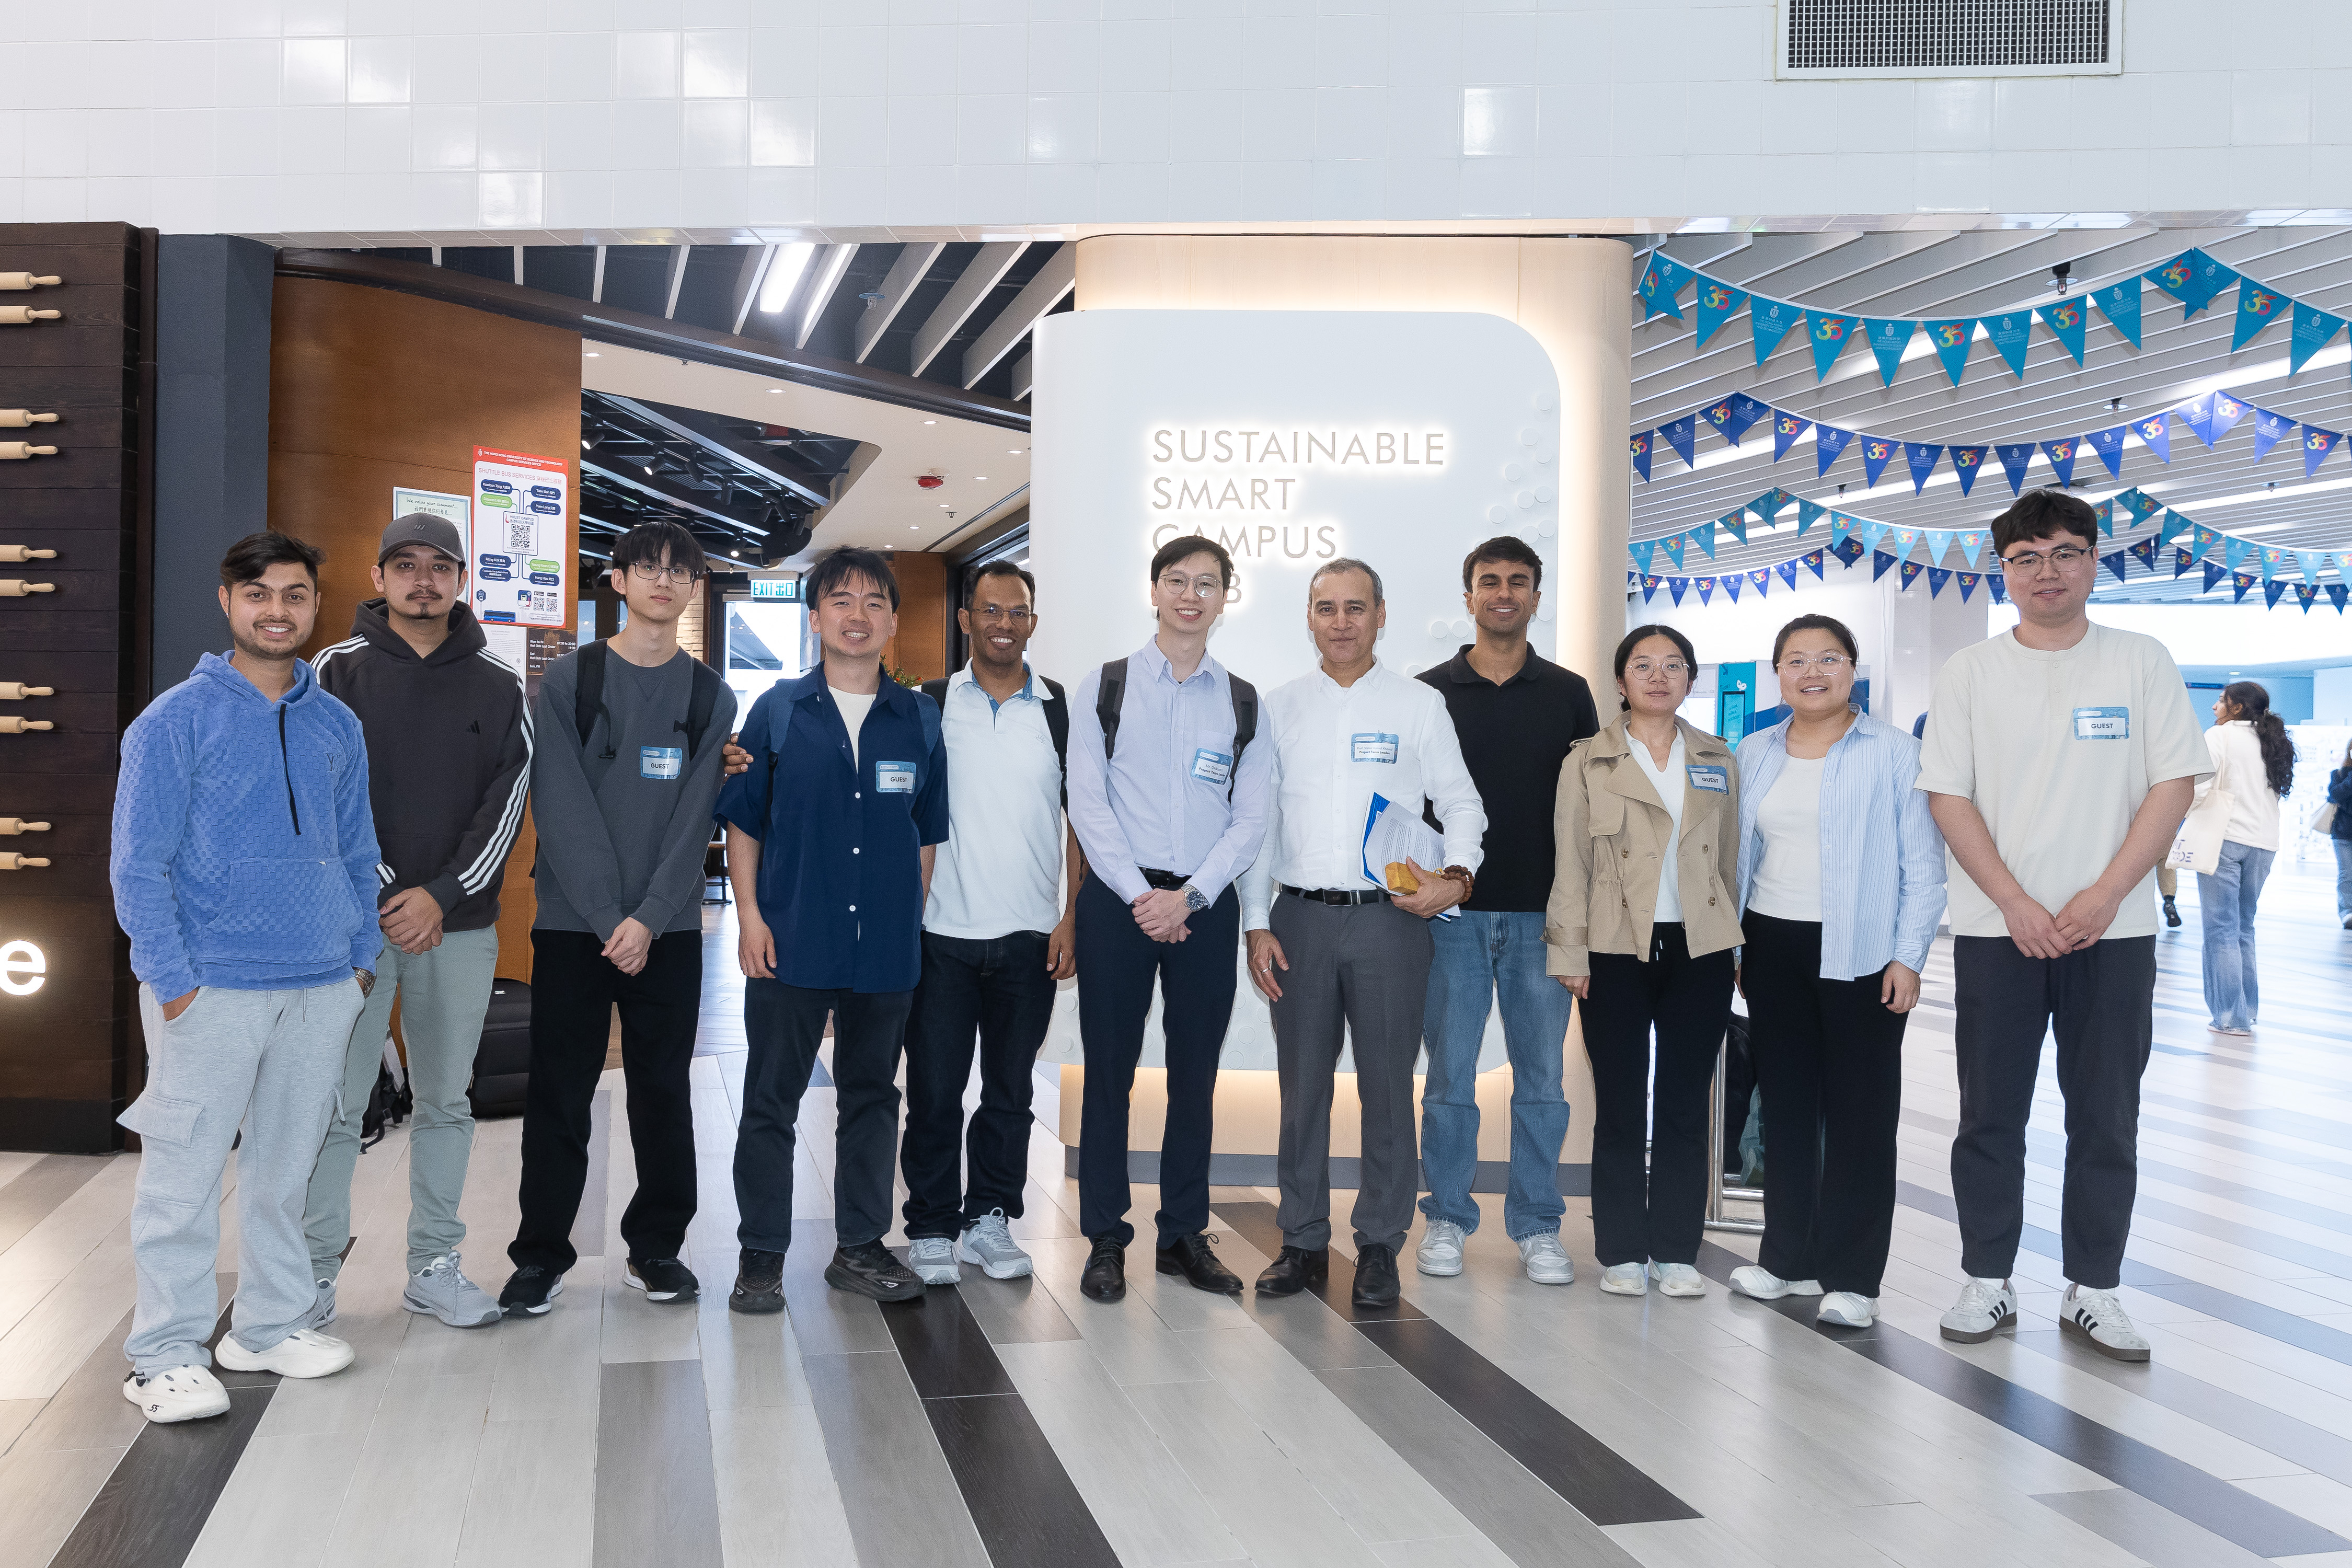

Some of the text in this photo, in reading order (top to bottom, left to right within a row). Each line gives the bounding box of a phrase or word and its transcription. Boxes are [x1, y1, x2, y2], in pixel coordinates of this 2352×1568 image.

[2162, 259, 2192, 289] 35
[1704, 285, 1734, 310] 35
[2244, 290, 2278, 316] 35
[1816, 317, 1845, 340] 35
[2053, 302, 2080, 330] 35
[1938, 322, 1965, 348] 35
[1778, 418, 1801, 435] 35
[1152, 430, 1444, 465] SUSTAINABLE
[1867, 442, 1889, 460] 35
[2052, 442, 2072, 462] 35
[2307, 433, 2331, 451] 35
[1957, 449, 1978, 467] 35
[1152, 477, 1296, 510] SMART
[753, 582, 793, 596] EXIT 出口
[0, 940, 46, 996] e
